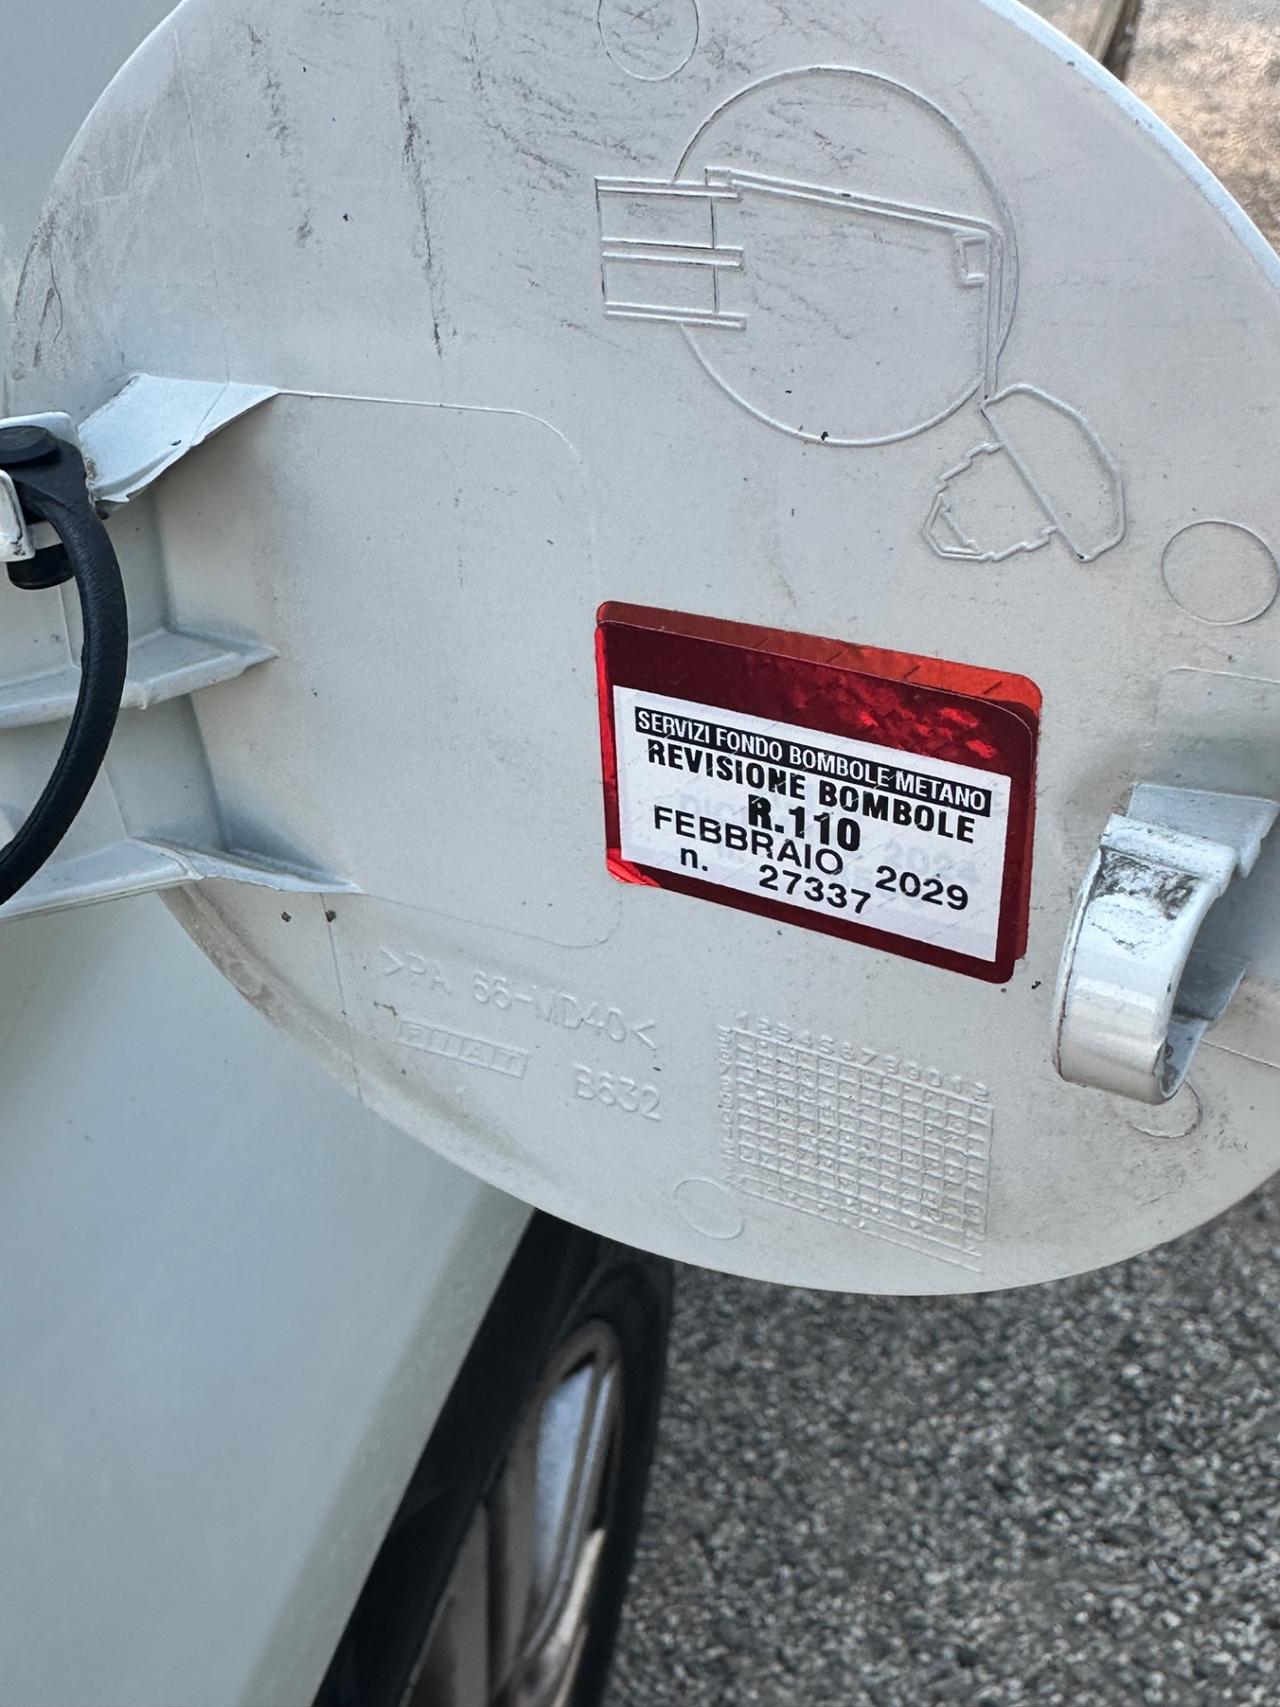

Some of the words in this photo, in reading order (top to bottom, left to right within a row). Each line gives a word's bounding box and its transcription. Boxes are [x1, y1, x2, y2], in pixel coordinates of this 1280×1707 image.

[637, 710, 711, 745] SERVIZI
[715, 728, 783, 763] FONDO
[788, 746, 890, 787] BOMBOLE
[895, 771, 987, 812] METANO
[647, 739, 806, 801] REVISIONE
[818, 781, 976, 844] BOMBOLE
[653, 805, 844, 876] FEBBRAIO
[874, 864, 969, 911] 2029
[748, 793, 862, 852] R.110
[679, 847, 709, 873] n.
[758, 864, 872, 915] 27337
